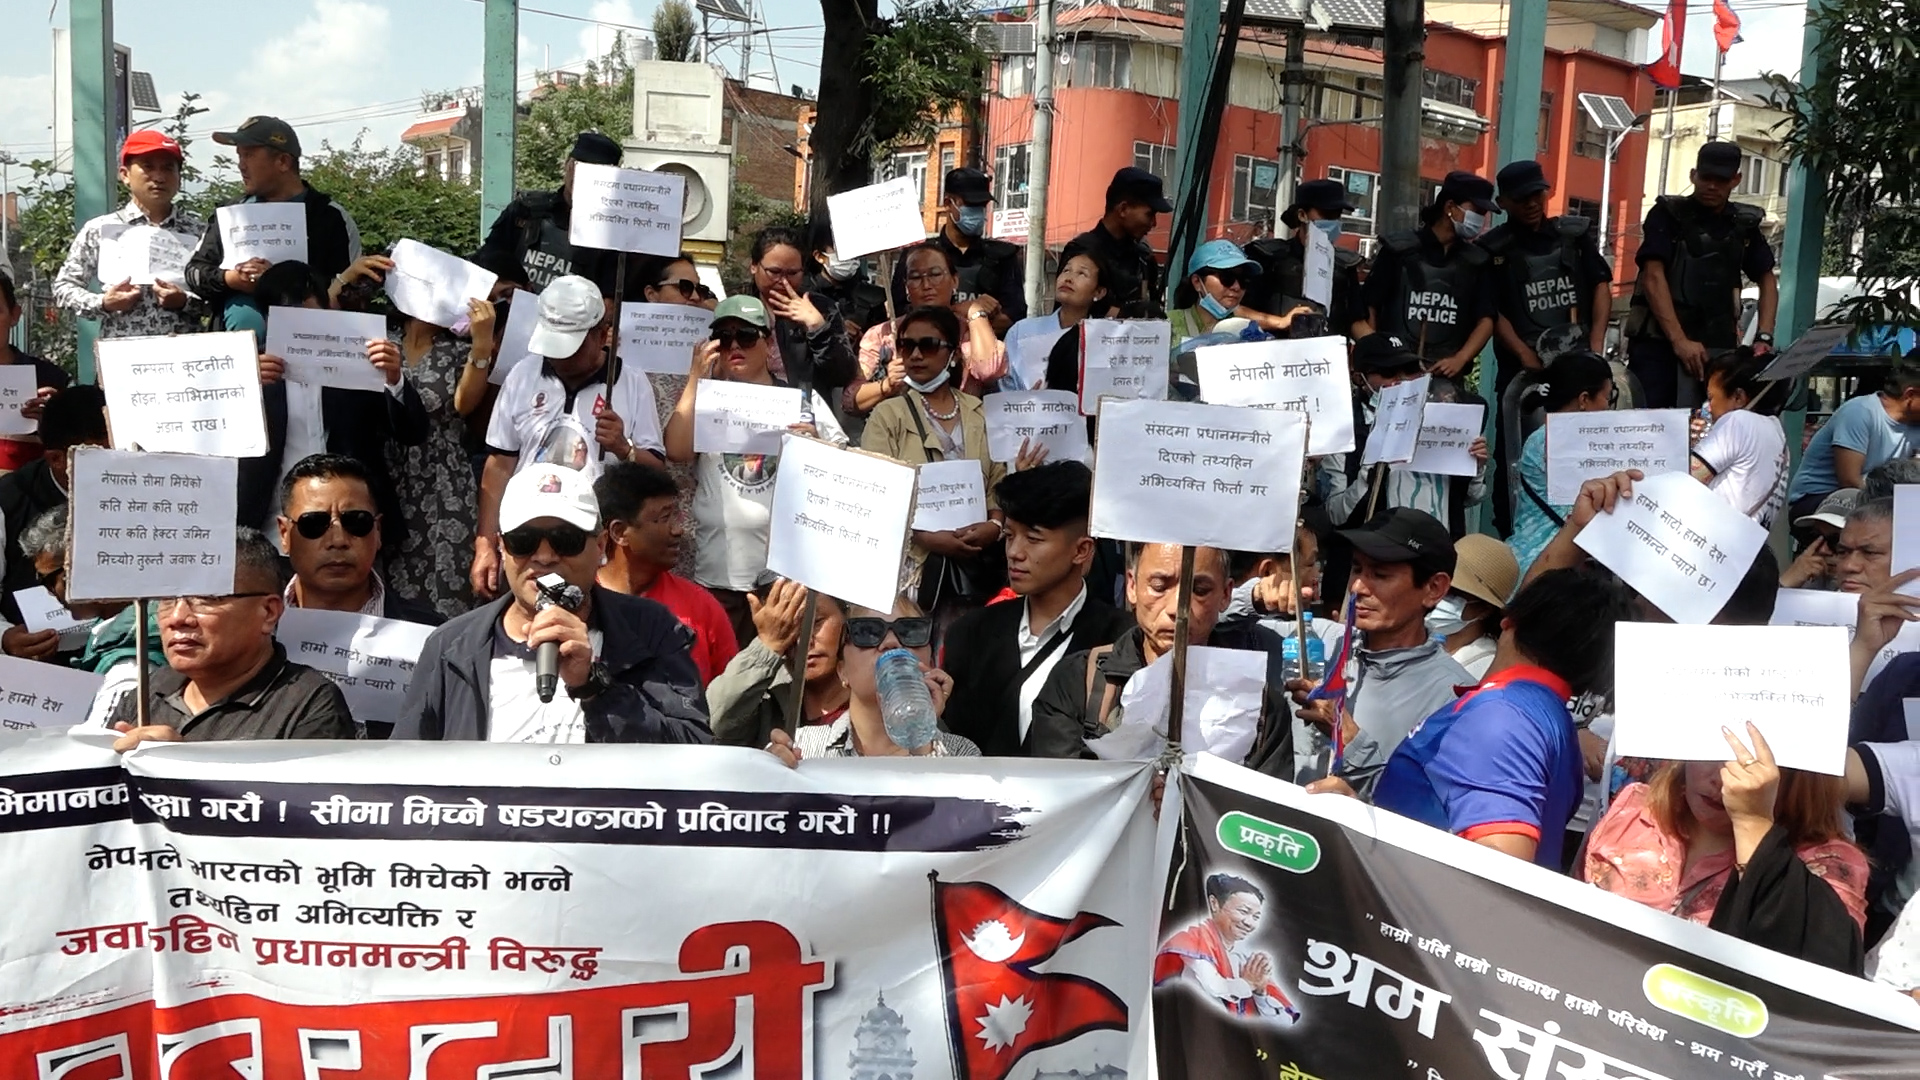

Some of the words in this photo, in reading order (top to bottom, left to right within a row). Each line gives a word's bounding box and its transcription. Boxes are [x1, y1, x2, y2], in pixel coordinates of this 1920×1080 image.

[523, 248, 573, 276] NEPAL
[1524, 275, 1575, 297] NEPAL
[1409, 290, 1458, 309] NEPAL
[1528, 291, 1578, 313] POLICE
[1408, 306, 1457, 325] POLICE
[1228, 361, 1276, 381] नेपाली
[1281, 358, 1332, 379] माटोको
[166, 384, 245, 403] स्वाभिमानको
[1003, 400, 1037, 413] नेपाली
[1041, 400, 1077, 413] माटोको
[190, 418, 219, 432] राख
[1015, 426, 1035, 437] रक्षा
[1144, 421, 1190, 438] संसदमा
[1196, 426, 1273, 445] प्रधानमन्त्रीले
[1158, 448, 1196, 464] दिएको
[1202, 453, 1254, 470] तथ्यहिन
[101, 469, 137, 486] नेपालले
[141, 472, 164, 487] सीमा
[170, 473, 202, 489] मिचेको
[1138, 473, 1206, 492] अभिव्यक्ति
[1212, 477, 1245, 496] फिर्ता
[1249, 484, 1269, 497] गर
[99, 496, 122, 512] कति
[127, 498, 147, 512] सेना
[152, 499, 172, 513] कति
[177, 500, 199, 516] प्रहरी
[98, 527, 122, 540] गएर
[126, 524, 148, 540] कति
[152, 525, 178, 541] हेक्टर
[183, 525, 211, 540] जमिन
[1635, 492, 1660, 515] हाम्रो
[1659, 509, 1683, 535] माटो,
[1682, 527, 1708, 550] हाम्रो
[1708, 543, 1728, 565] देश
[1625, 518, 1669, 556] प्राणभन्दा
[1670, 553, 1698, 577] प्यारो
[169, 554, 196, 566] जवाफ
[300, 640, 328, 655] हाम्रो
[334, 646, 363, 665] माटो,
[365, 653, 395, 668] हाम्रो
[364, 678, 396, 691] प्यारो
[7, 690, 38, 707] हाम्रो
[41, 696, 64, 713] देश
[0, 782, 130, 816] भिमानक
[309, 793, 394, 827] सीमा
[402, 794, 489, 828] मिच्ने
[497, 800, 667, 832] षडयन्त्रको
[676, 800, 791, 834] प्रतिवाद
[871, 812, 892, 835] !!
[1239, 824, 1306, 859] प्रकृति
[186, 858, 303, 885] भारतको
[316, 861, 377, 893] भूमि
[388, 862, 491, 892] मिचेको
[504, 864, 574, 893] भन्ने
[167, 887, 281, 925] तथ्यहिन
[295, 899, 443, 929] अभिव्यक्ति
[456, 909, 477, 929] र
[252, 935, 471, 972] प्रधानमन्त्री
[1298, 937, 1453, 1041] श्रम
[1379, 920, 1413, 945] हाम्रो
[1416, 935, 1452, 961] धर्ति
[1454, 950, 1492, 976] हाम्रो
[1495, 966, 1560, 1002] आकाश
[1563, 992, 1603, 1019] हाम्रो
[1606, 1008, 1669, 1042] परिवेश
[1688, 1039, 1724, 1063] श्रम
